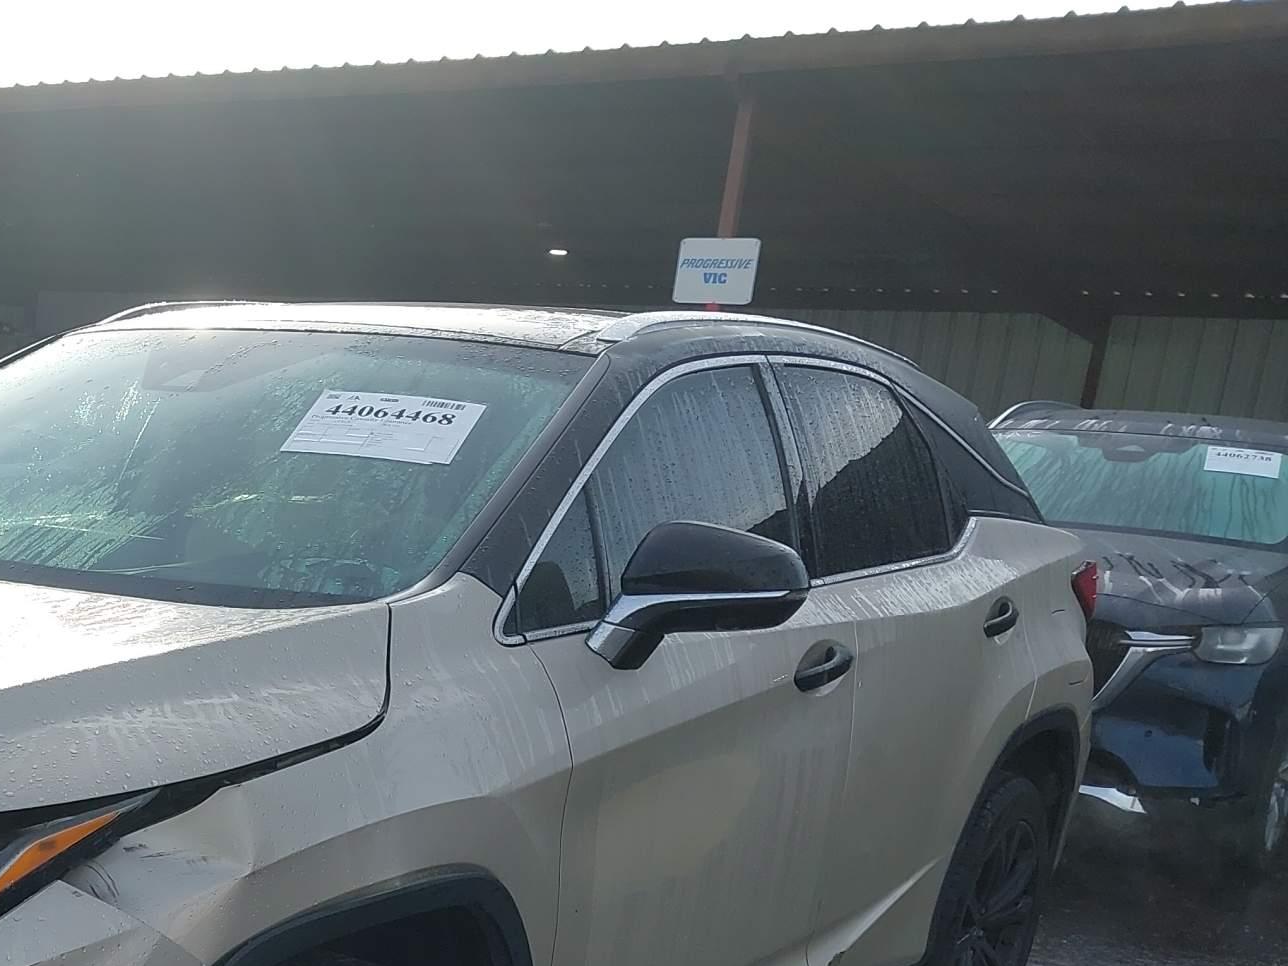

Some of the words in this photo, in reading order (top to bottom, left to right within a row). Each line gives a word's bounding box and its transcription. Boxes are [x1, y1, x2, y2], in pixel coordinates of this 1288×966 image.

[680, 258, 753, 269] PROGRESSIVE
[703, 272, 728, 285] VIC
[325, 403, 456, 425] 44064468
